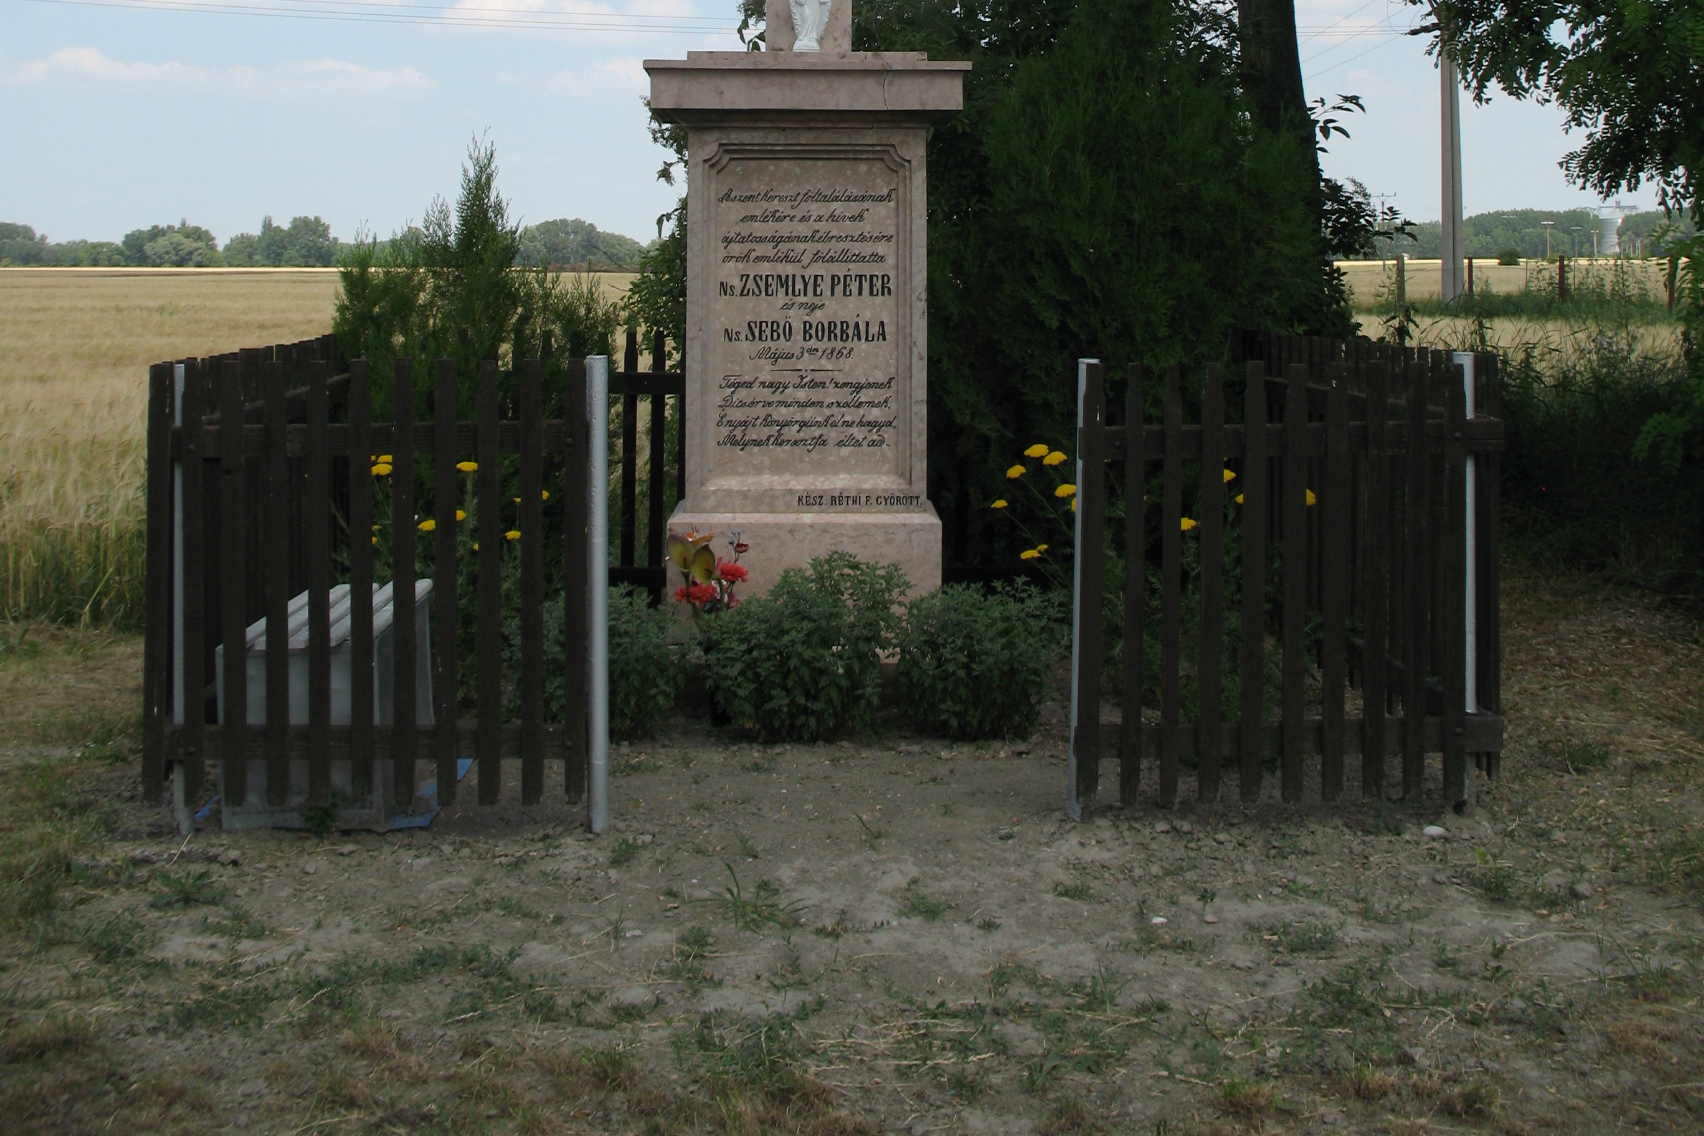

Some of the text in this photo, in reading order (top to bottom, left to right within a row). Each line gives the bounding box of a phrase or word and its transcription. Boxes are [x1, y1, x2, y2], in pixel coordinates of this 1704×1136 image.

[797, 210, 812, 223] és
[813, 214, 824, 223] a
[721, 248, 756, 264] örök
[752, 248, 808, 264] emlékül
[719, 268, 892, 298] Ns. ZSEMLYE PÉTER
[779, 298, 826, 316] és neje
[723, 327, 743, 343] Ns.
[802, 314, 887, 343] BORBÁLA
[748, 346, 795, 366] Május
[757, 380, 791, 395] nagy
[775, 397, 825, 409] minden
[840, 420, 856, 428] ne
[833, 434, 867, 448] éltet
[797, 492, 827, 506] KÉSZ.
